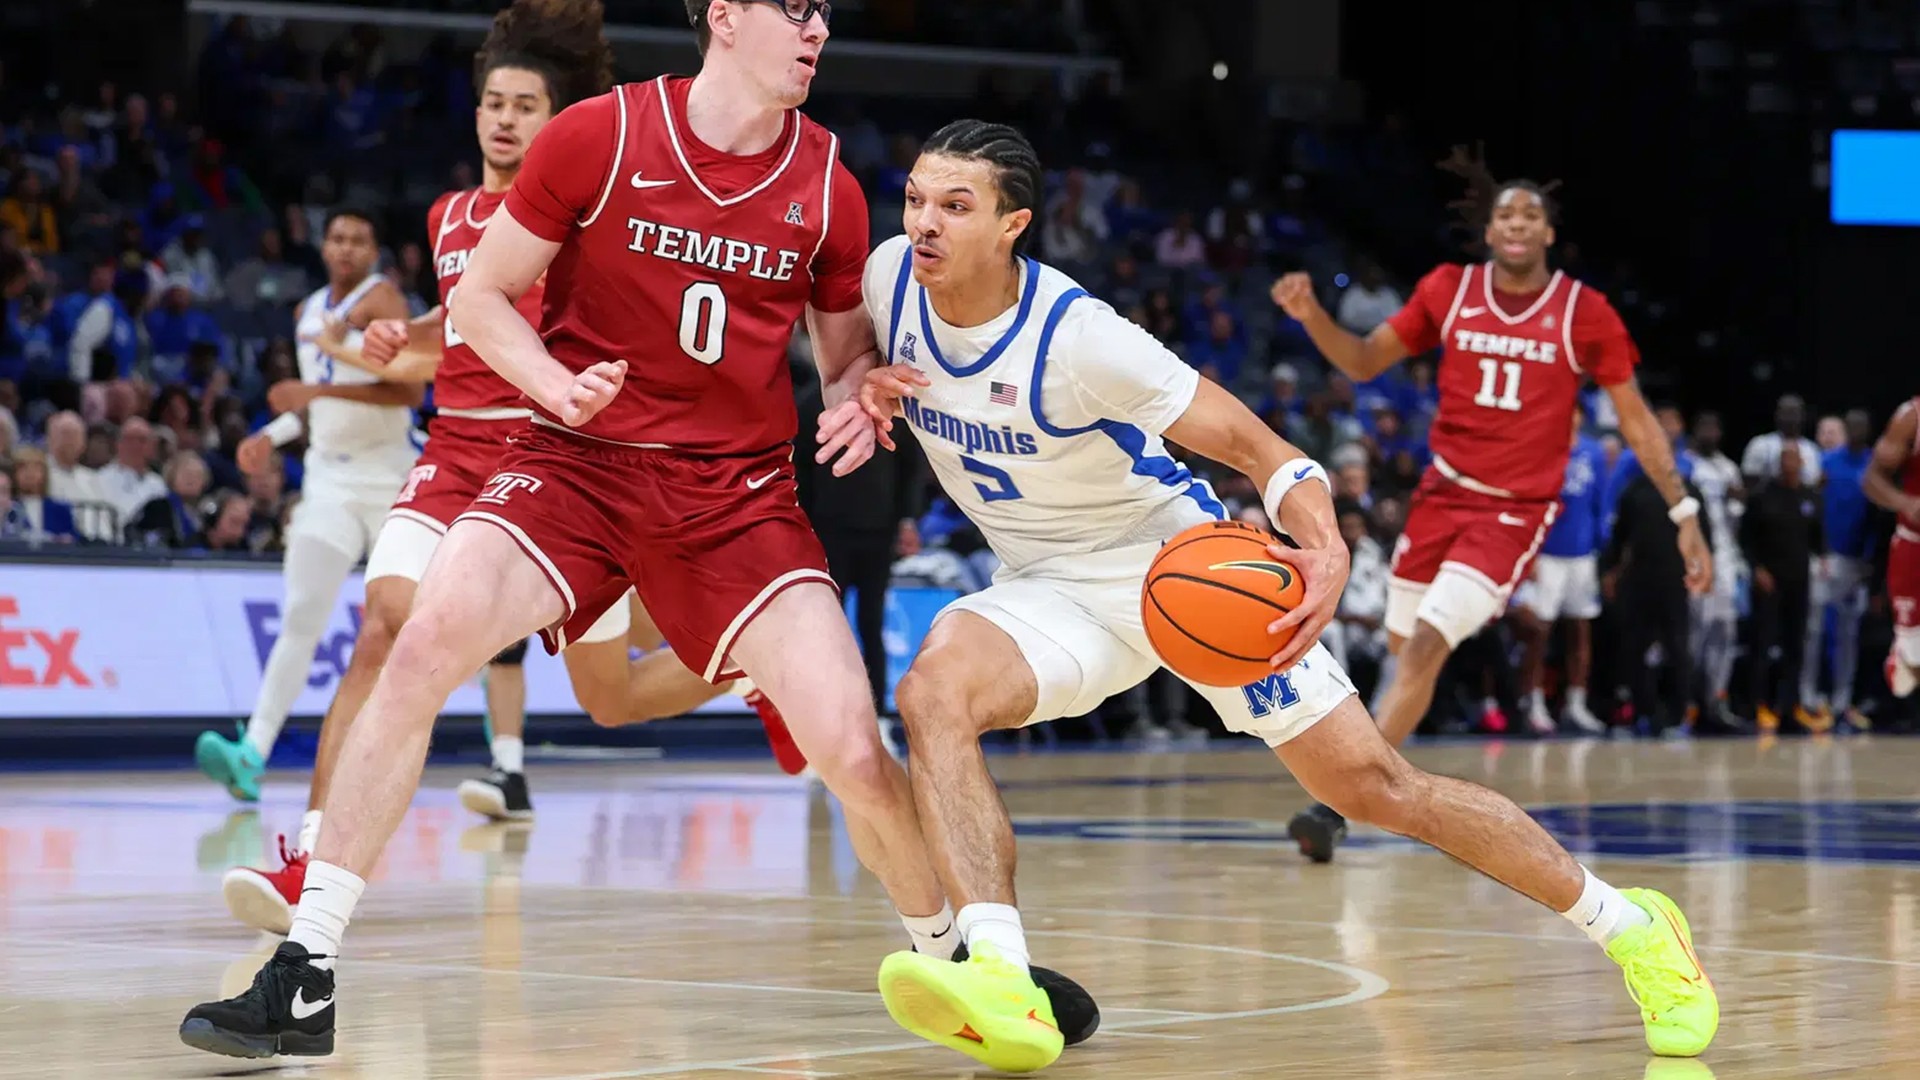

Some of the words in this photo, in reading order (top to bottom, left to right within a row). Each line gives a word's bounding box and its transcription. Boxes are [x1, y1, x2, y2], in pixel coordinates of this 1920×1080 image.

[437, 248, 476, 280] TEM
[627, 217, 800, 281] TEMPLE
[678, 281, 728, 366] 0
[1455, 329, 1557, 364] TEMPLE
[1473, 358, 1522, 411] 11
[901, 395, 1038, 455] Memphis
[474, 472, 544, 506] T
[1241, 673, 1301, 718] M
